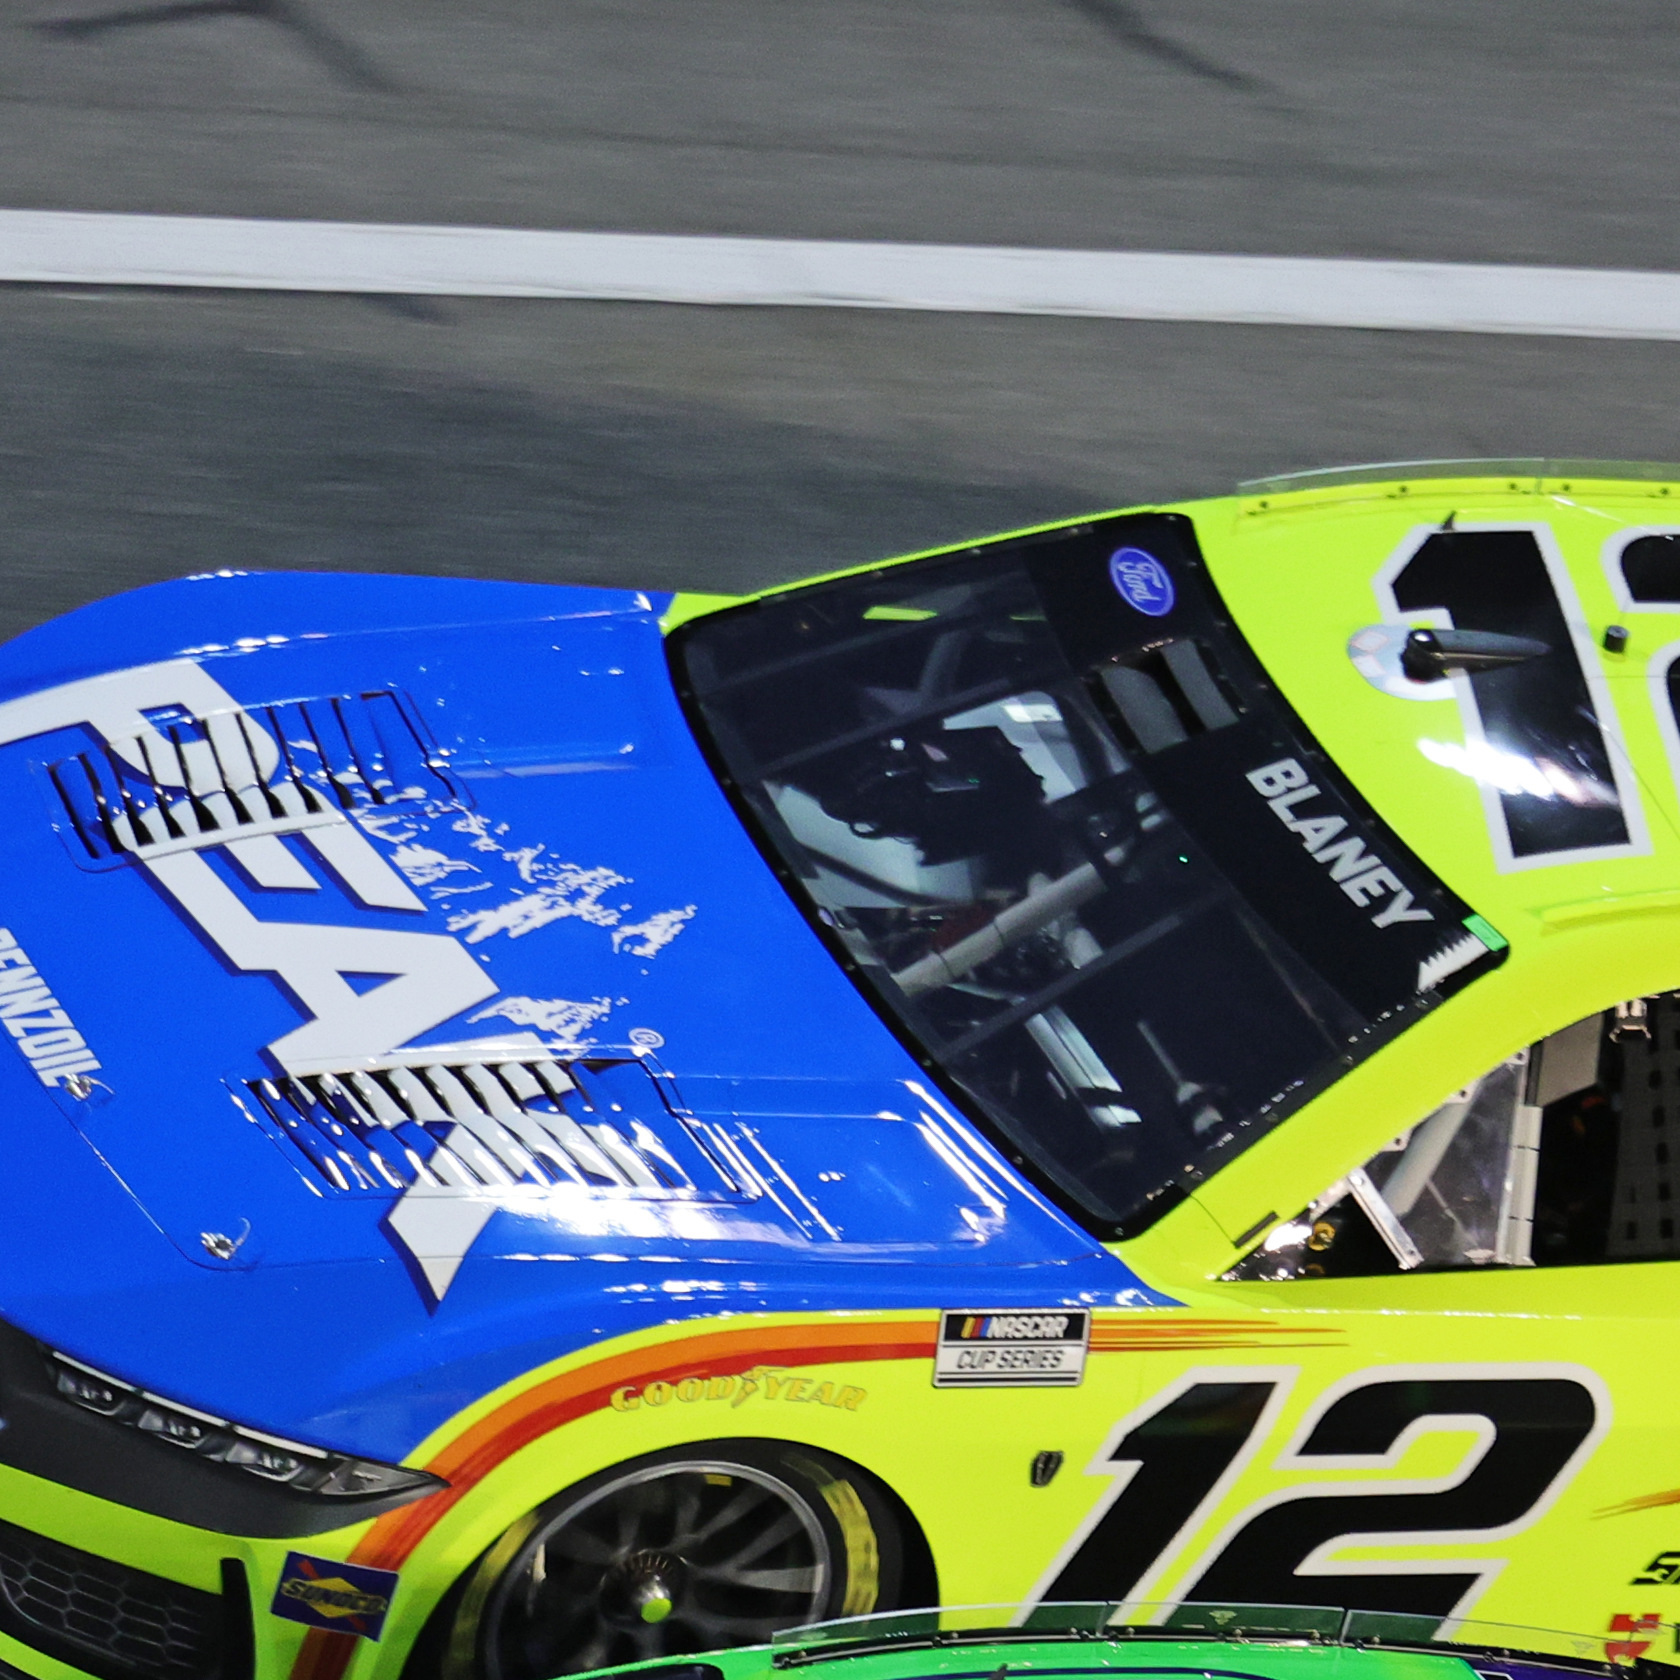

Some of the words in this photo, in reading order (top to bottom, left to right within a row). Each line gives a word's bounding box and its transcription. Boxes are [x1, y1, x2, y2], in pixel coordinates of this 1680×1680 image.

[1247, 758, 1433, 928] BLANEY
[986, 1316, 1069, 1339] NASCAR
[956, 1349, 996, 1369] CUP
[997, 1349, 1065, 1370] SERIES
[610, 1367, 868, 1412] GOODYEAR
[1010, 1361, 1613, 1641] 12
